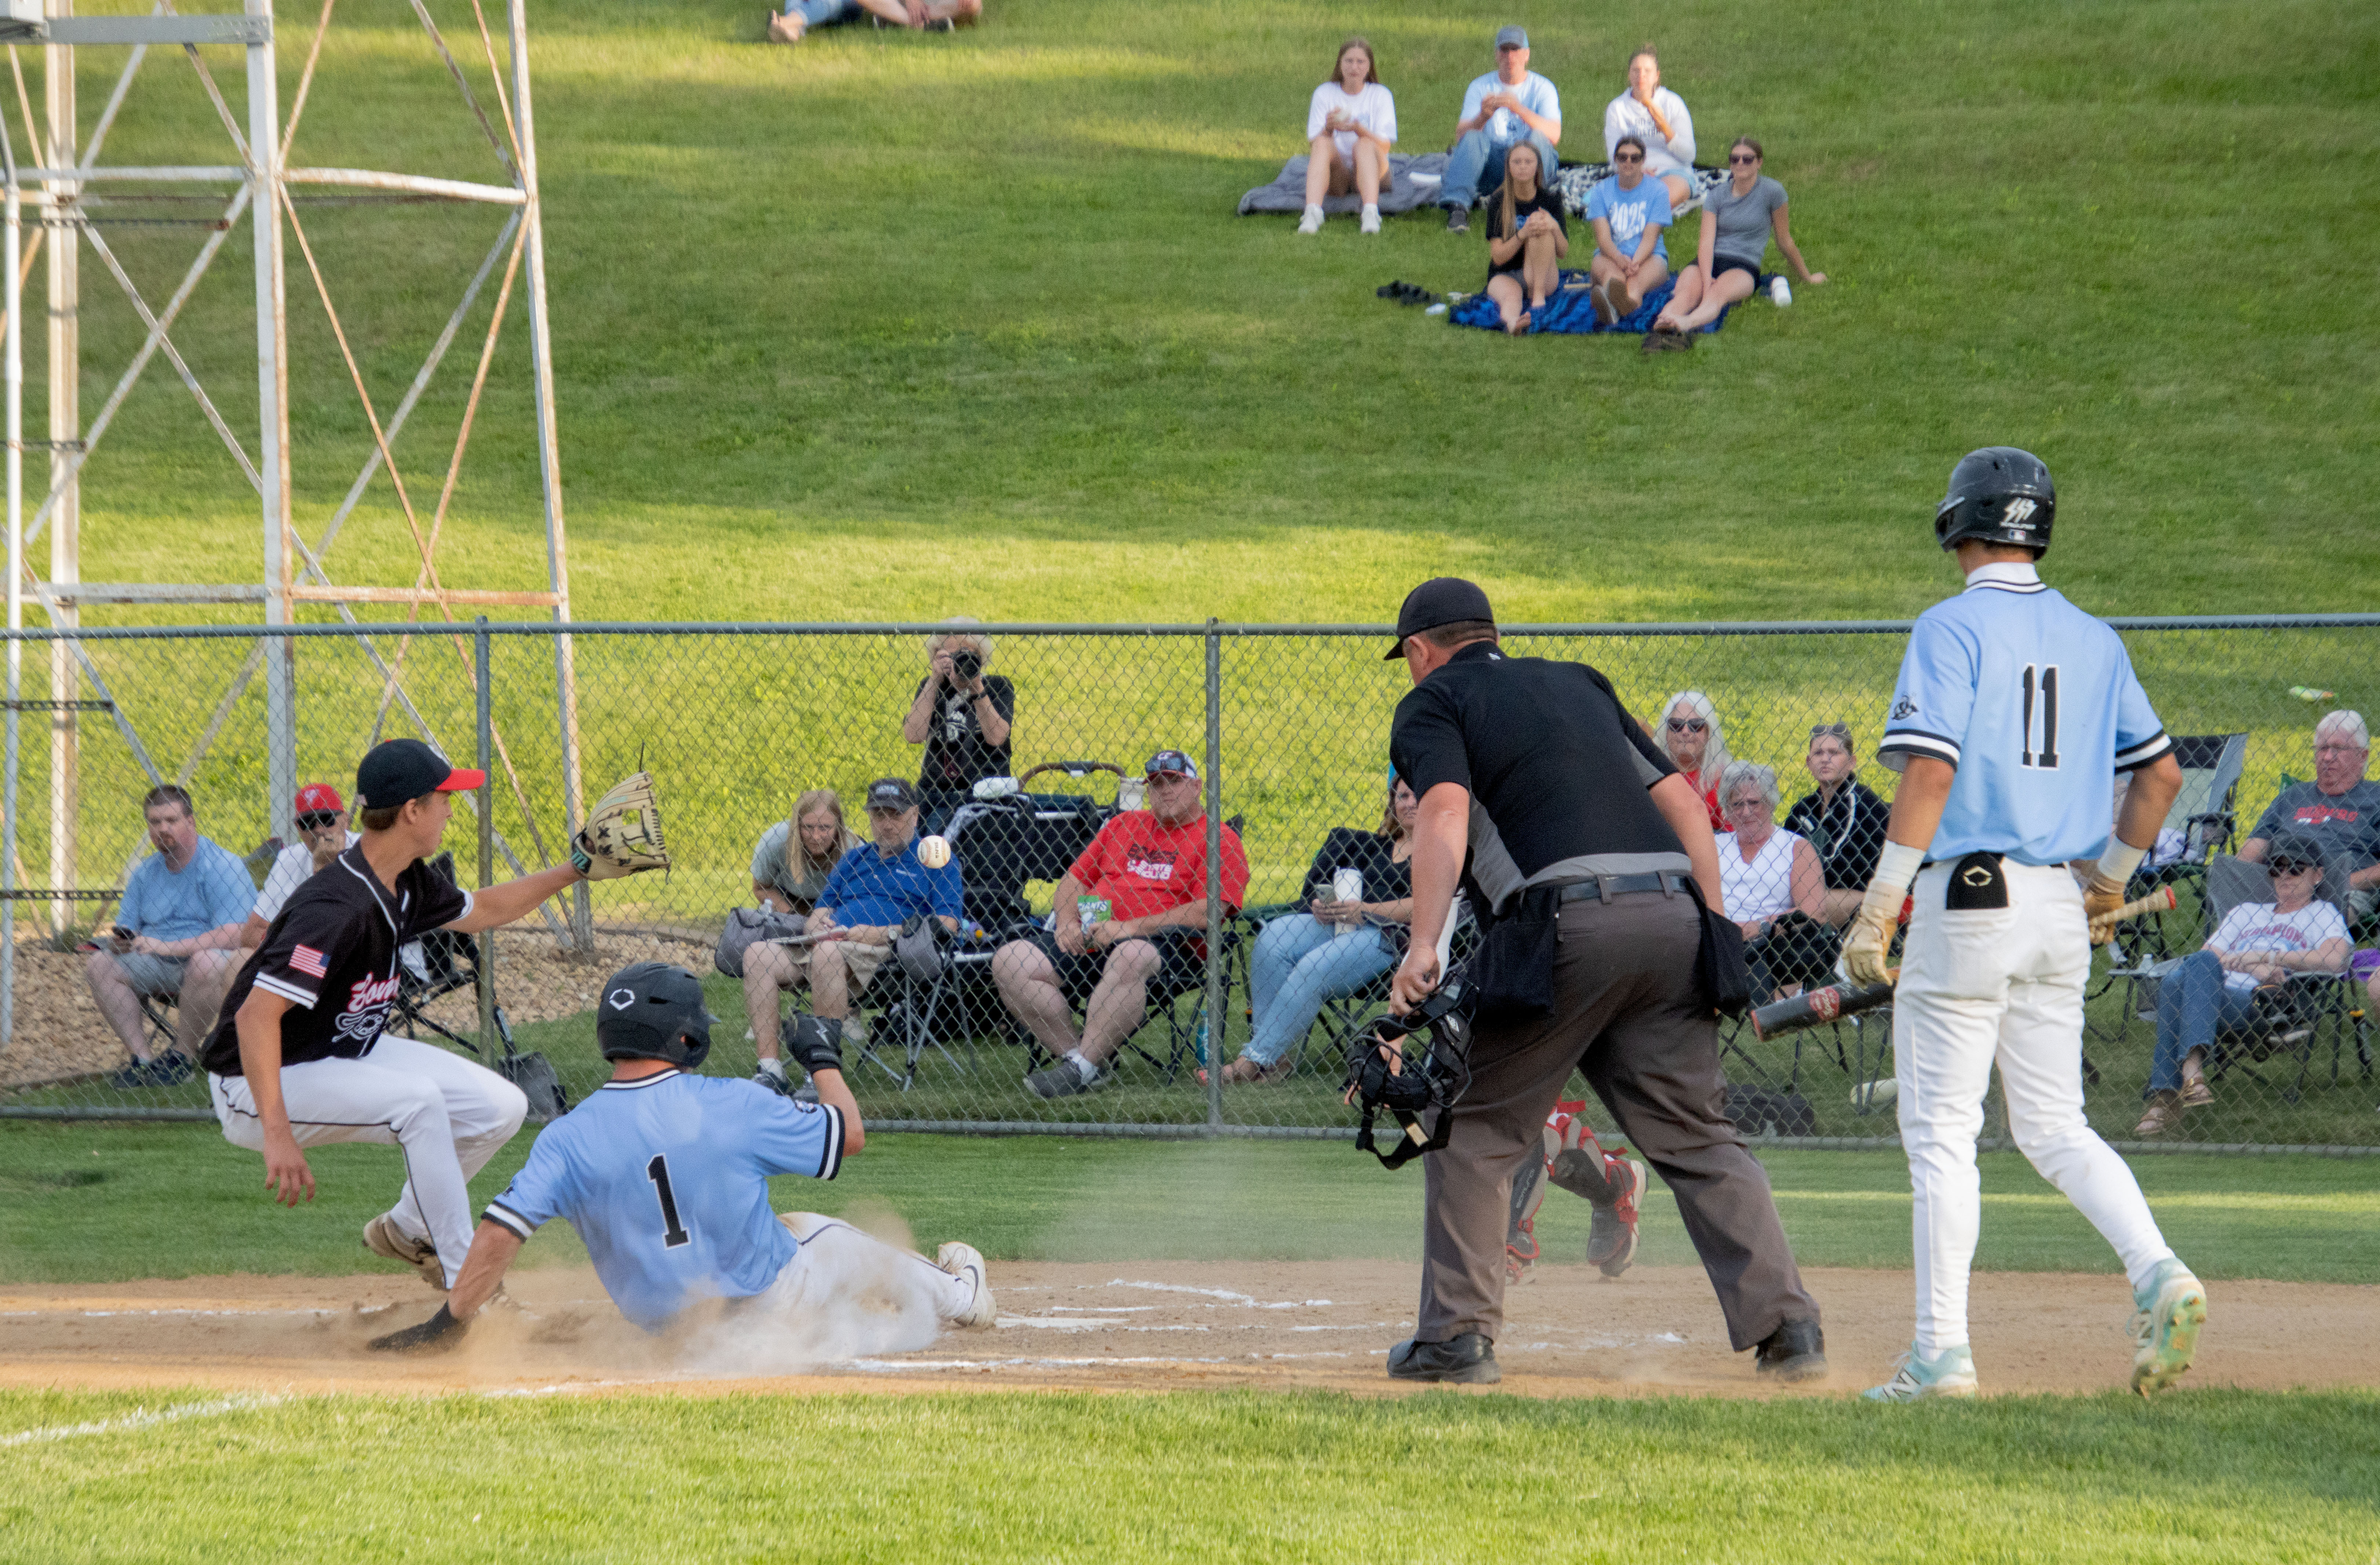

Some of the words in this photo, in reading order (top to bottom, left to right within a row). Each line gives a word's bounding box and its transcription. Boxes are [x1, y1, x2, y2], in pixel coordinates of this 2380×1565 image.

[1609, 201, 1647, 232] 2025
[2020, 662, 2059, 770] 11
[645, 1152, 692, 1250] 1
